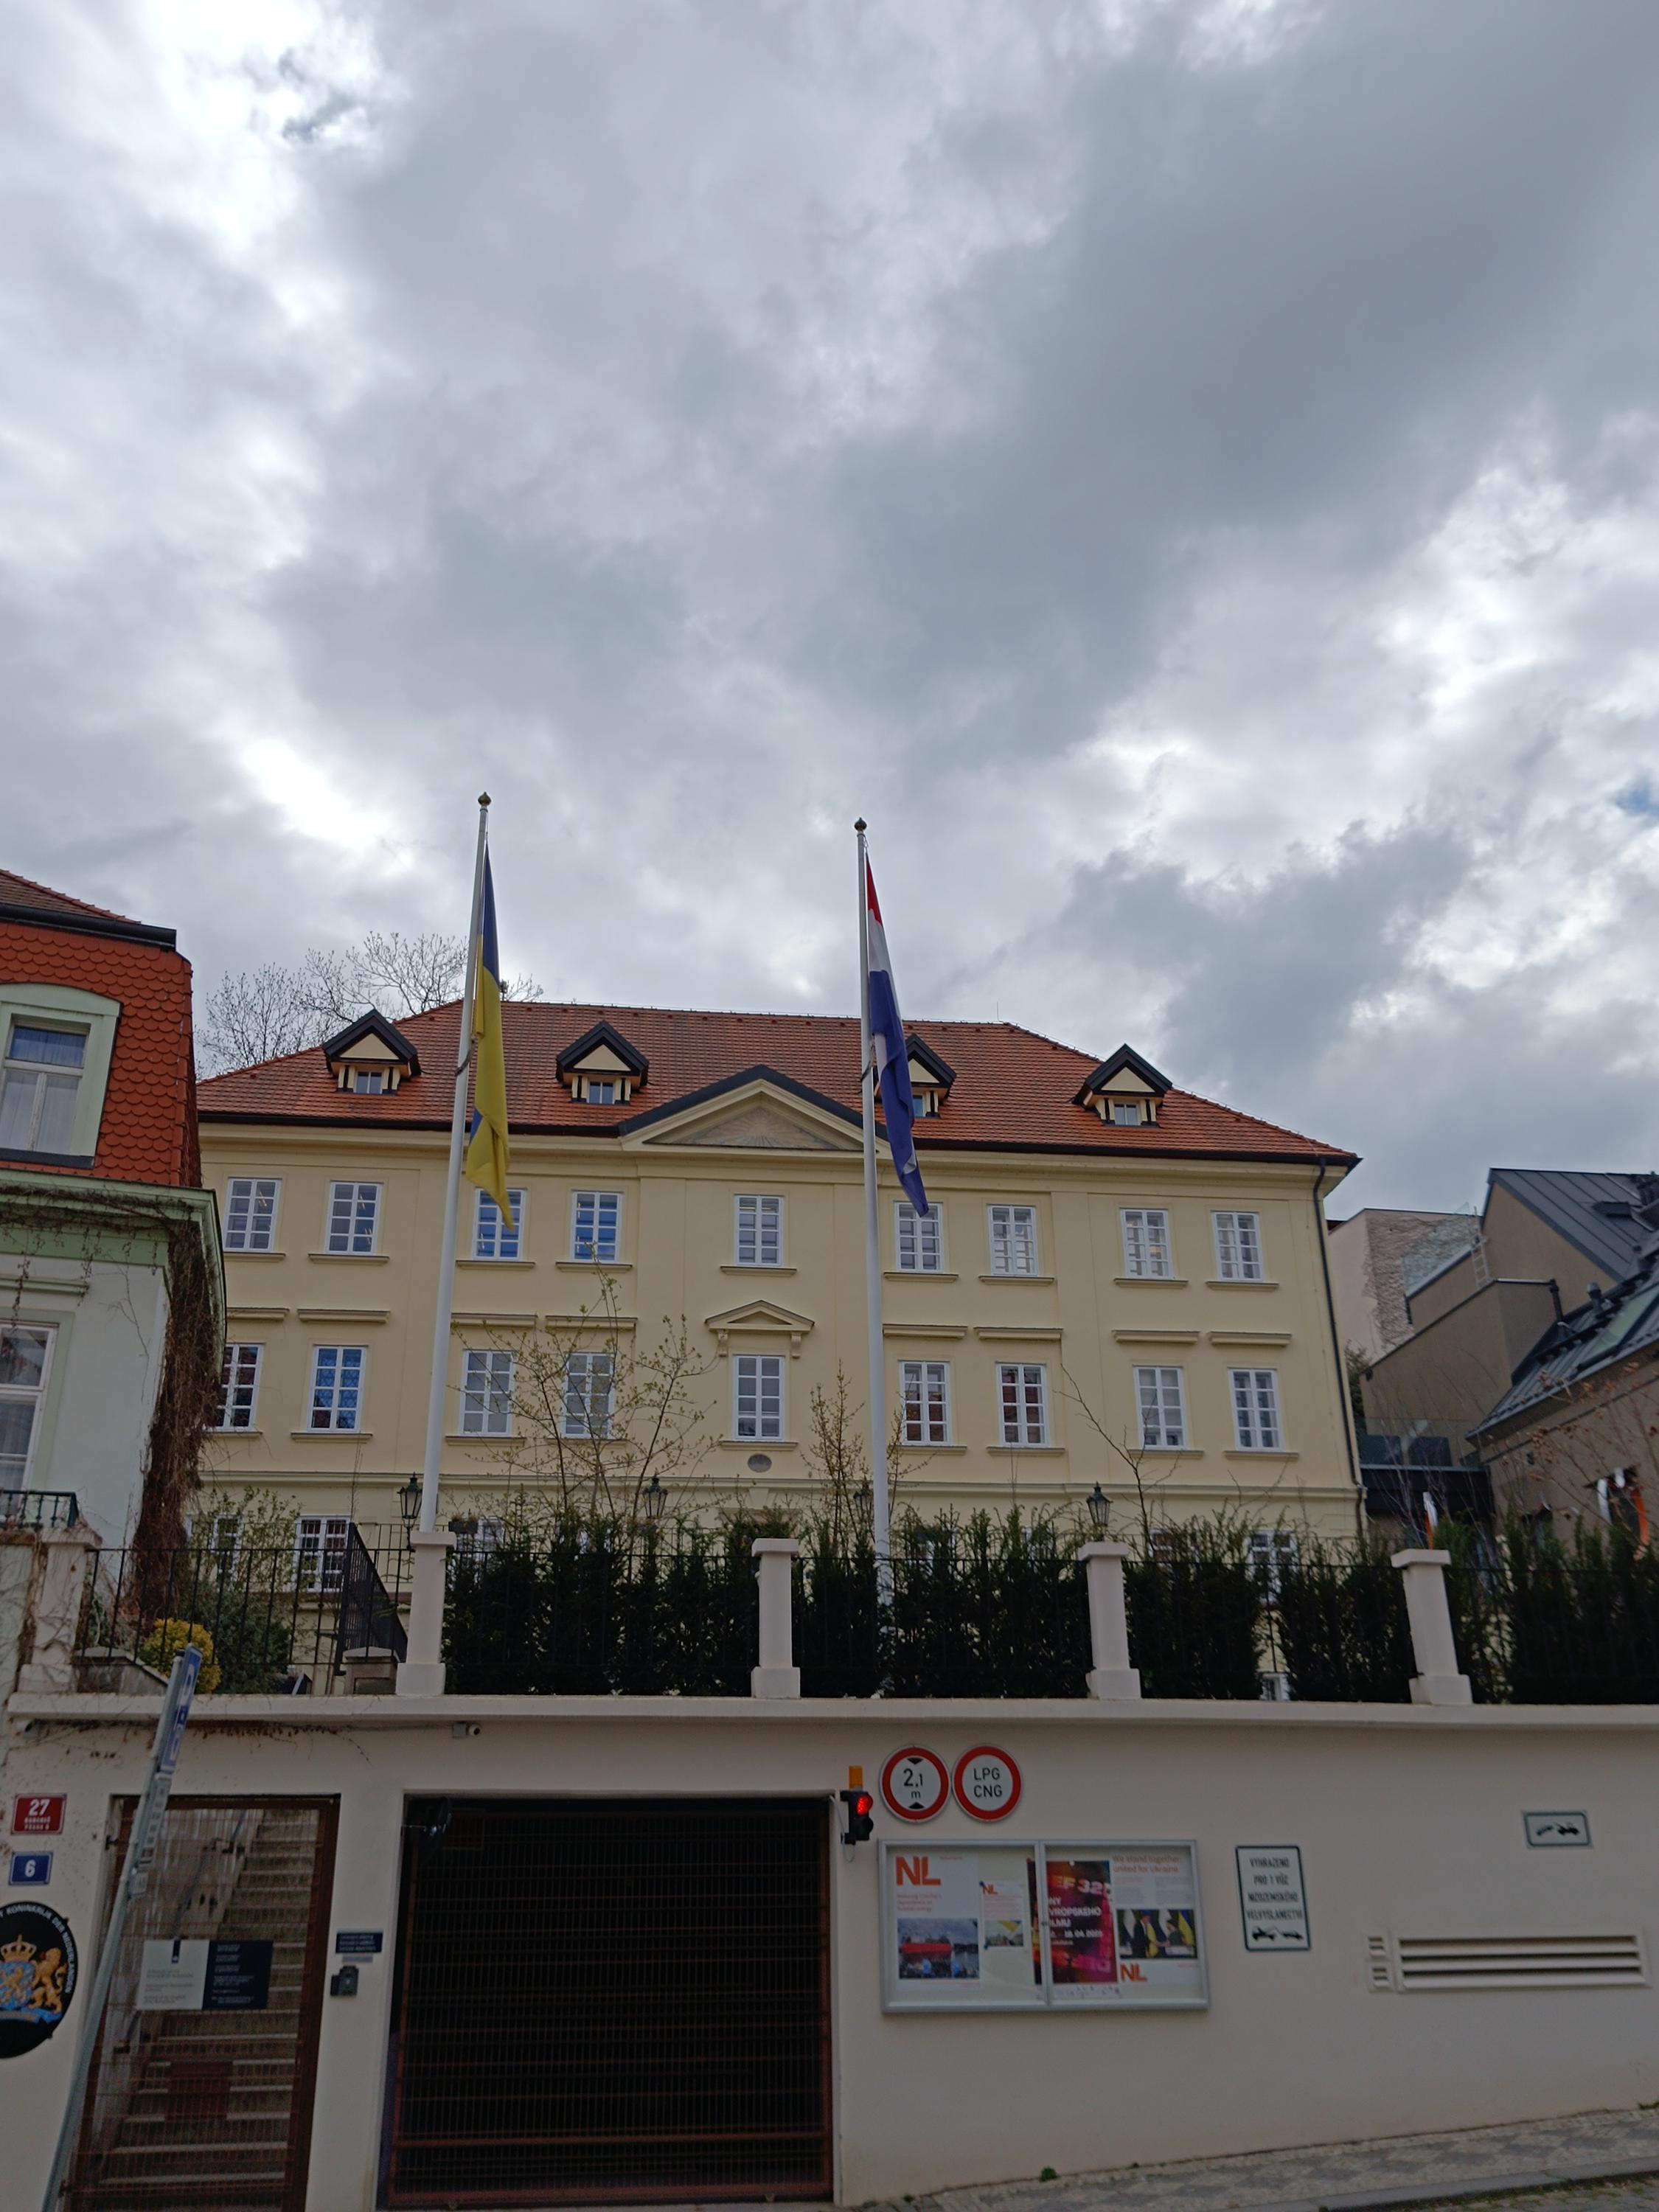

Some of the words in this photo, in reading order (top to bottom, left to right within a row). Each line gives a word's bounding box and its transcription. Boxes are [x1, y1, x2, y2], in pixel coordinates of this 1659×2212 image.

[973, 1767, 1000, 1781] LPG
[973, 1784, 1003, 1798] CNG
[29, 1798, 51, 1816] 27
[1125, 1854, 1145, 1863] stand
[1147, 1854, 1180, 1865] together
[1249, 1857, 1290, 1868] VYHRAZENO
[25, 1859, 36, 1877] 6
[895, 1855, 942, 1886] NL
[1253, 1874, 1267, 1885] PRO
[982, 1885, 998, 1894] NL
[1120, 1963, 1147, 1982] NL
